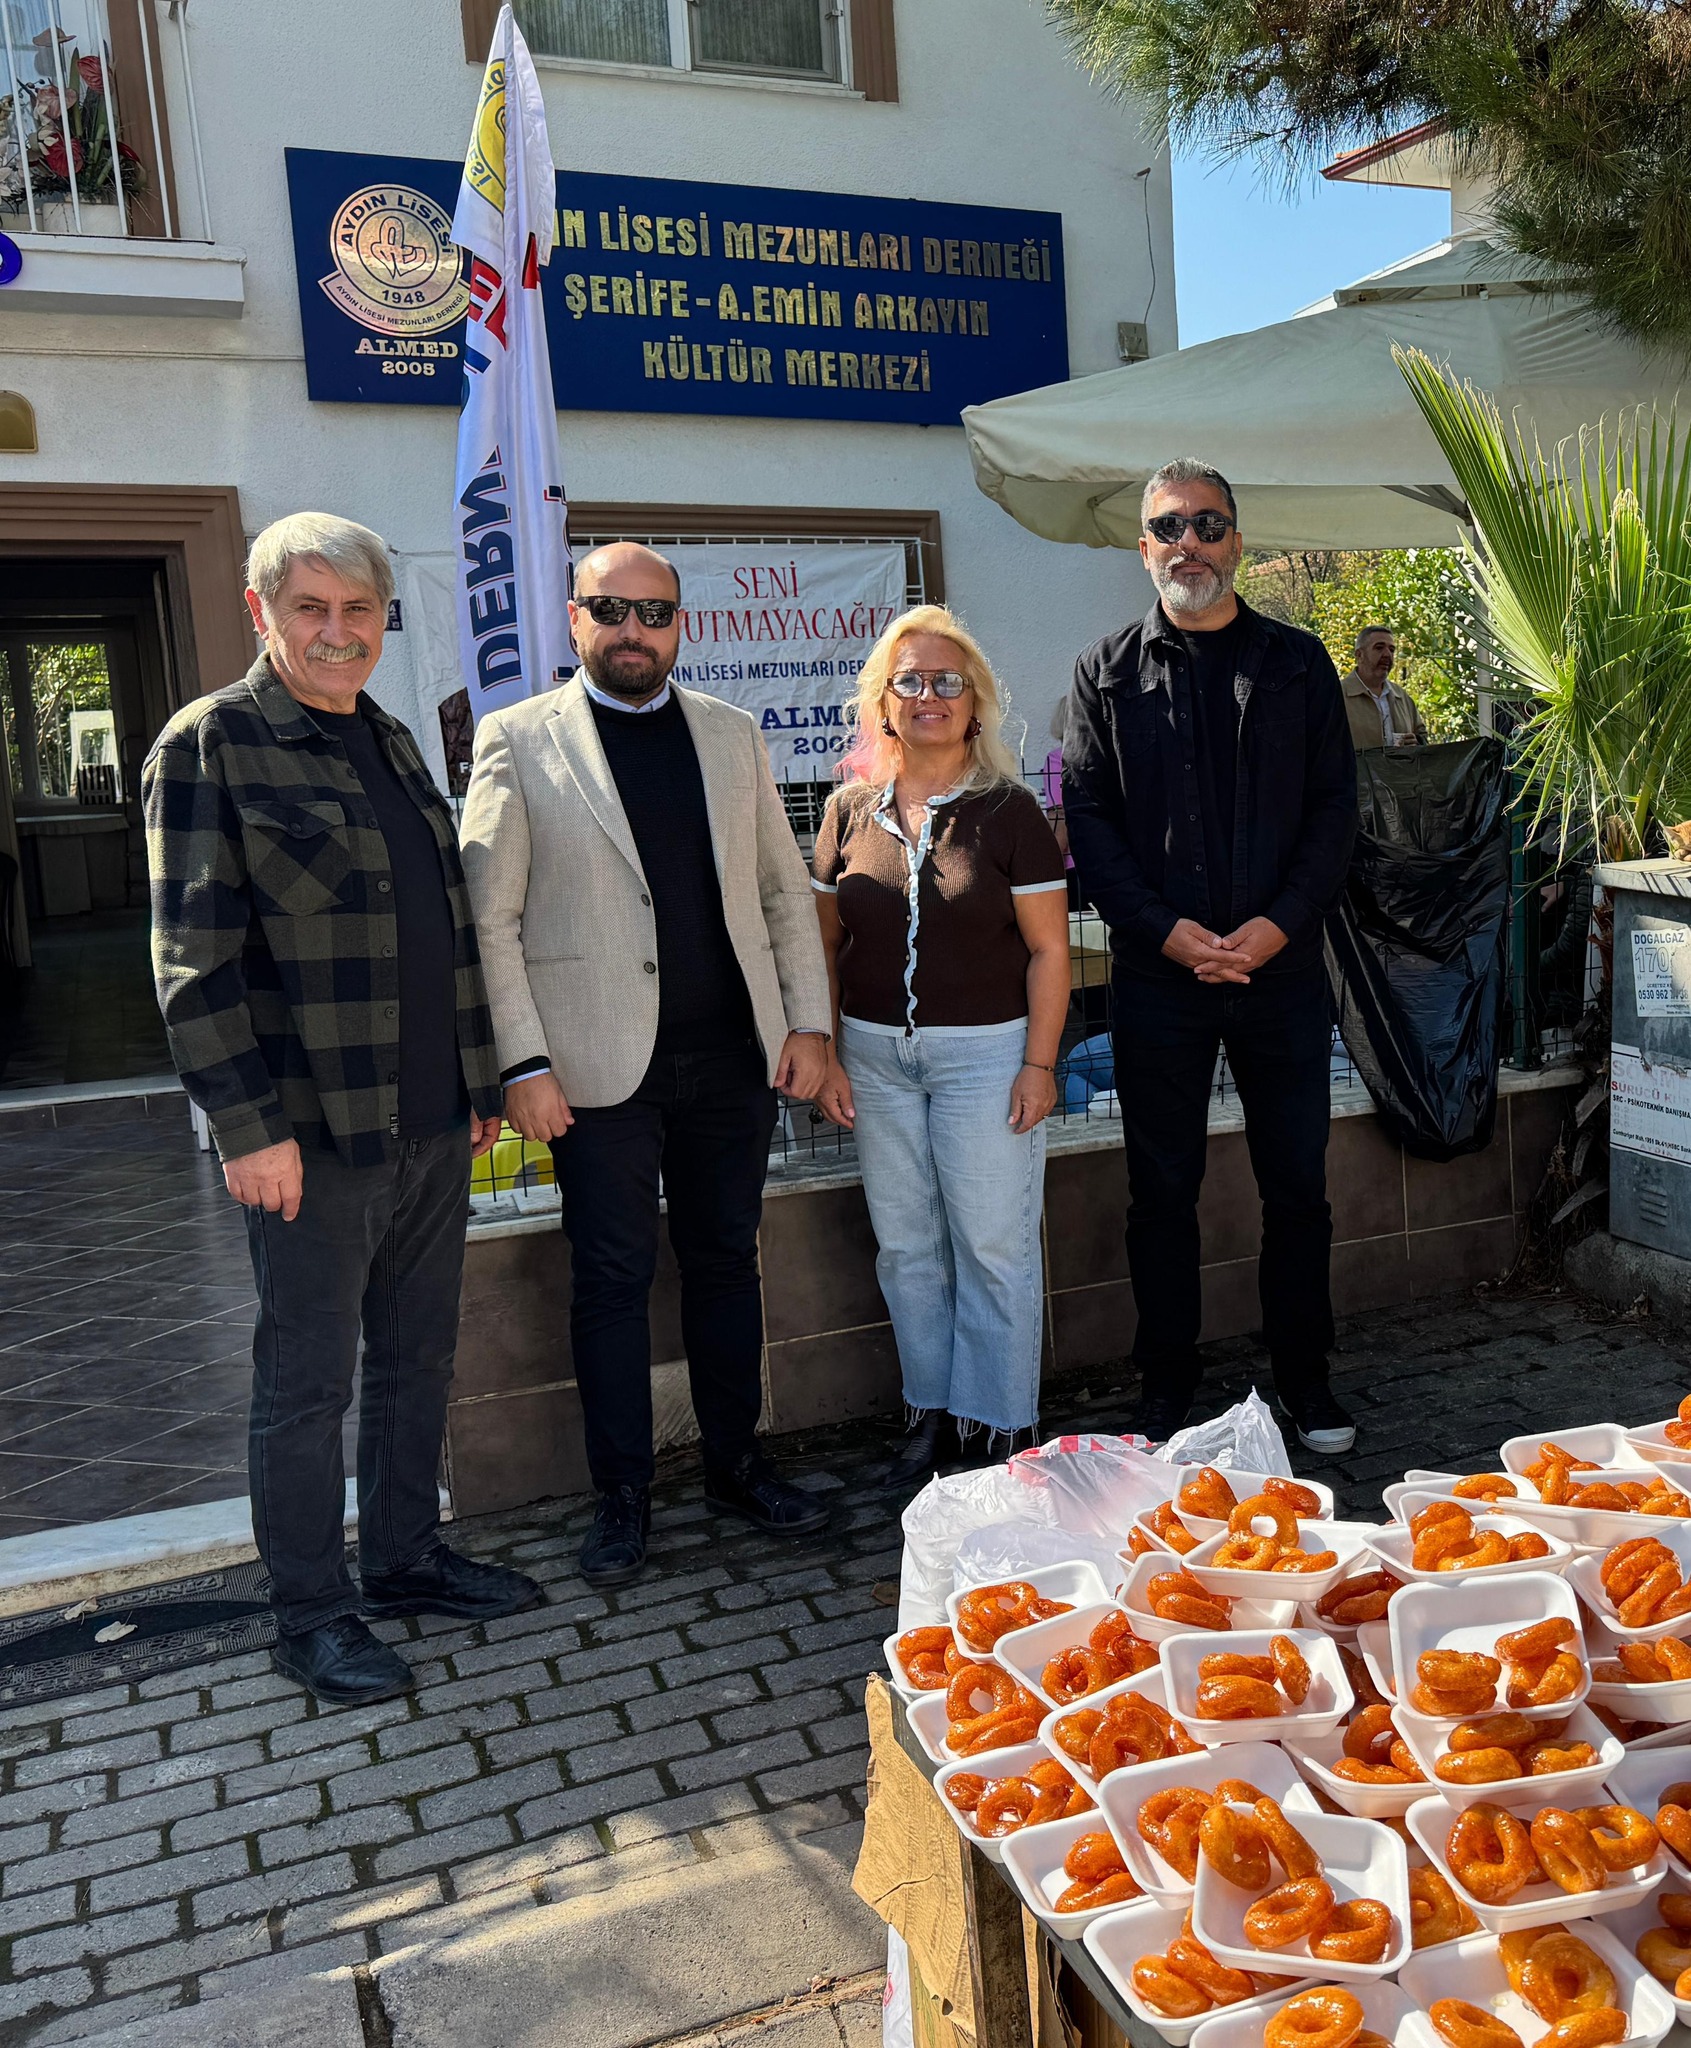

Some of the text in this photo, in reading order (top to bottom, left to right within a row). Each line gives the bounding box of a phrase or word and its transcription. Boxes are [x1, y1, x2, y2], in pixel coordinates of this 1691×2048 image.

[341, 193, 388, 247] AYDIN
[599, 205, 710, 257] LİSESİ
[722, 220, 912, 272] MEZUNLARI
[924, 237, 1052, 283] DERNEĞİ
[336, 285, 358, 307] AYDIN
[358, 304, 386, 322] LİSESİ
[387, 315, 436, 326] MEZUNLARI
[381, 289, 426, 305] 1948
[854, 292, 989, 337] ARKAYIN
[354, 337, 459, 359] ALMED
[643, 335, 932, 392] KÜLTÜR MERKEZİ
[381, 360, 436, 377] 2005
[733, 560, 800, 600] SENİ
[683, 601, 895, 644] UTMAYACAĞIZ
[697, 659, 744, 681] LİSESİ
[747, 659, 834, 680] MEZUNLARI
[1635, 946, 1670, 973] 170
[1665, 1106, 1691, 1119] DANIŞMA
